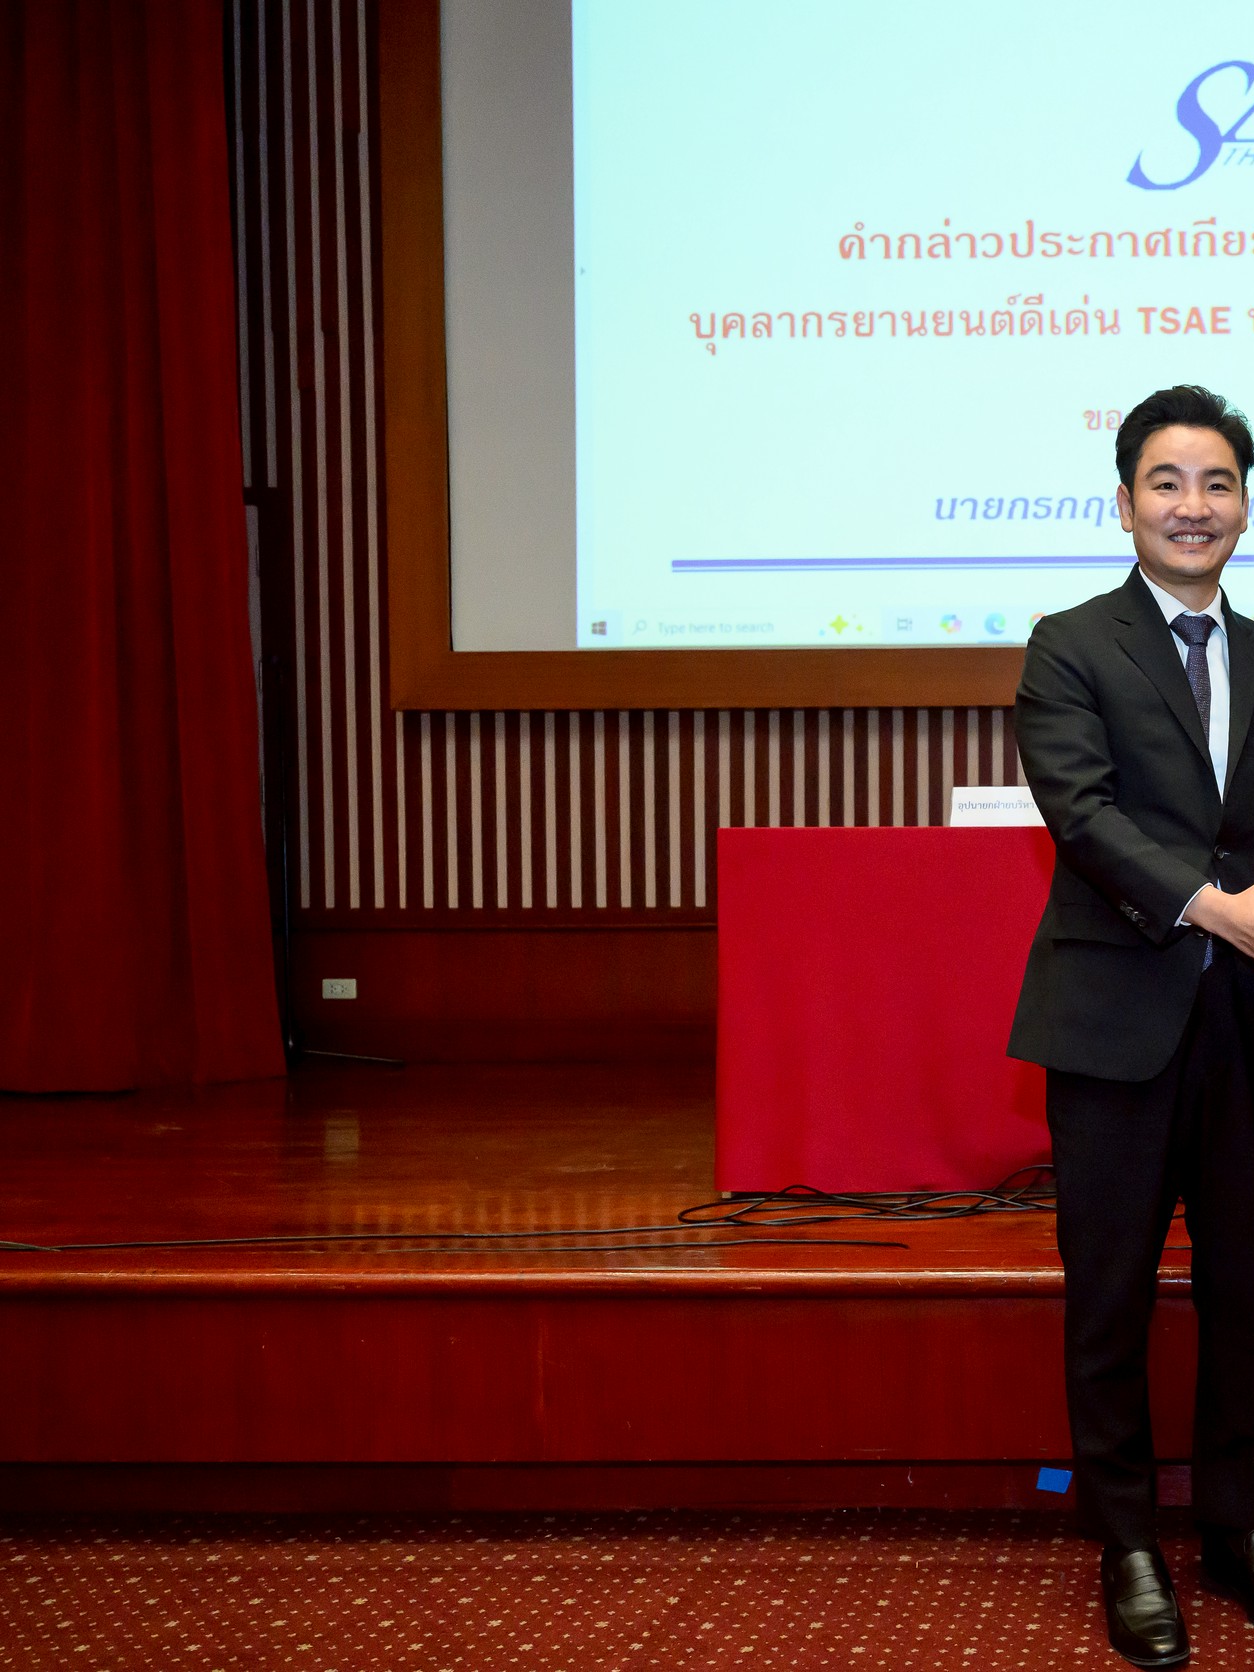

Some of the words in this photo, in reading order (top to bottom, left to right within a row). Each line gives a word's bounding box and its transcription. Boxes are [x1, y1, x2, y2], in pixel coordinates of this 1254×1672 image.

[689, 293, 1121, 356] บุคลากรยานยนต์ดีเด่น
[1138, 307, 1232, 335] TSAE
[1083, 409, 1122, 431] ขอ
[658, 622, 686, 636] Type
[688, 622, 716, 634] here
[719, 622, 732, 634] to
[736, 621, 774, 634] search
[958, 800, 1035, 812] อุปนายกฝ่ายบริหา
